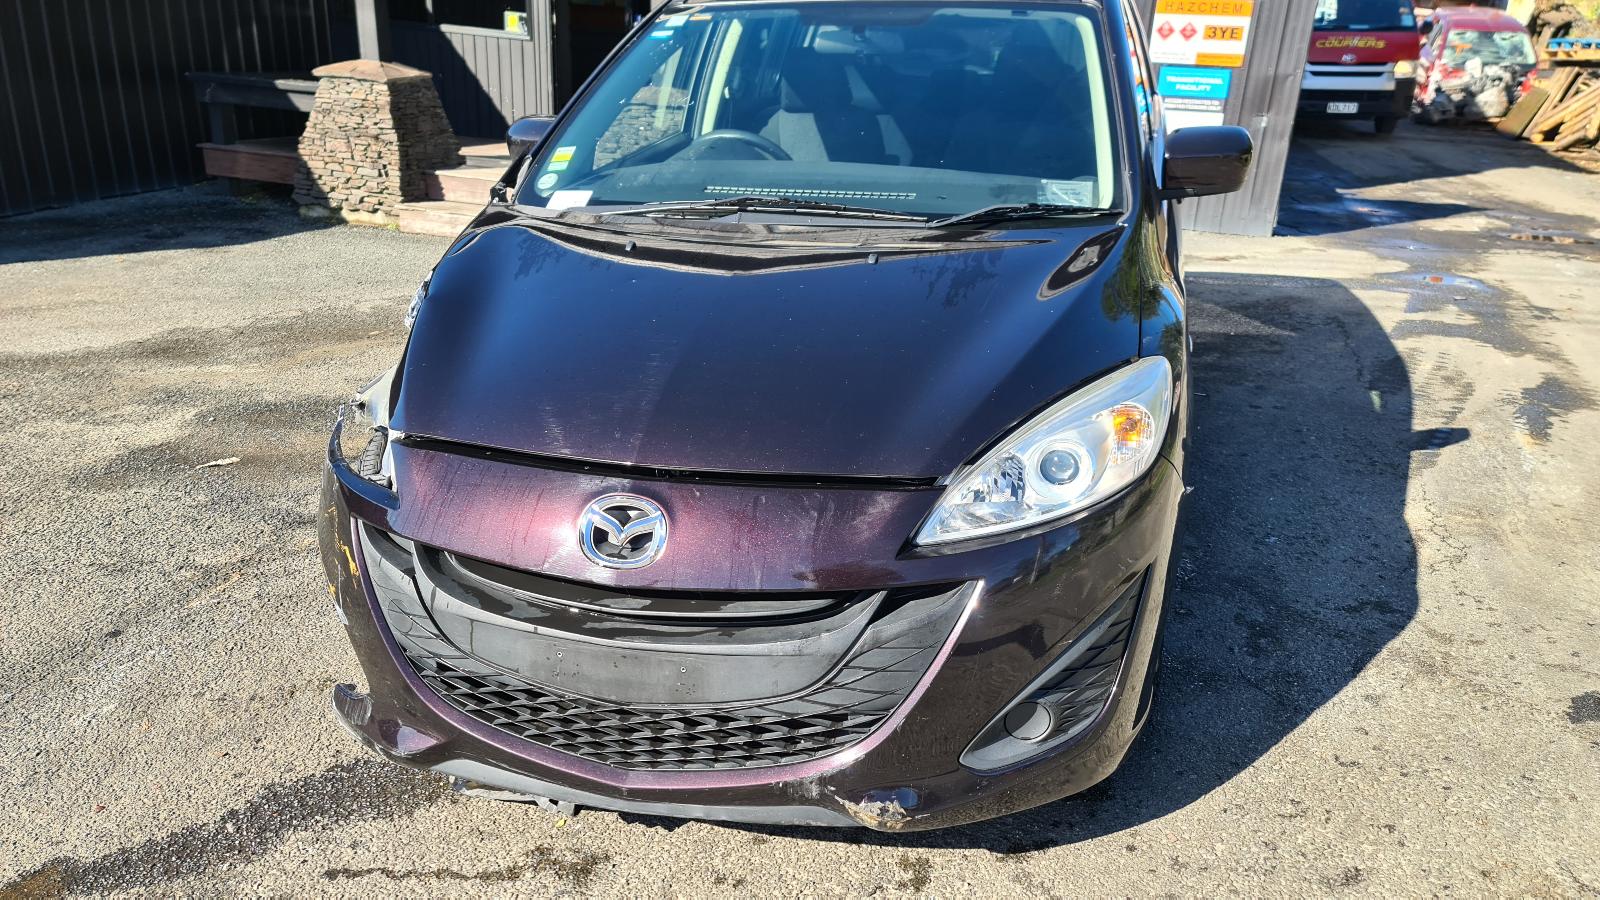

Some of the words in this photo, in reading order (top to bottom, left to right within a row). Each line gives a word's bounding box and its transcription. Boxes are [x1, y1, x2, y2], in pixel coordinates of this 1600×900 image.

[1165, 2, 1243, 14] HAZCHEM
[1208, 26, 1240, 39] 3YE
[1316, 38, 1386, 48] COURIERS
[1175, 83, 1211, 92] FACILITY
